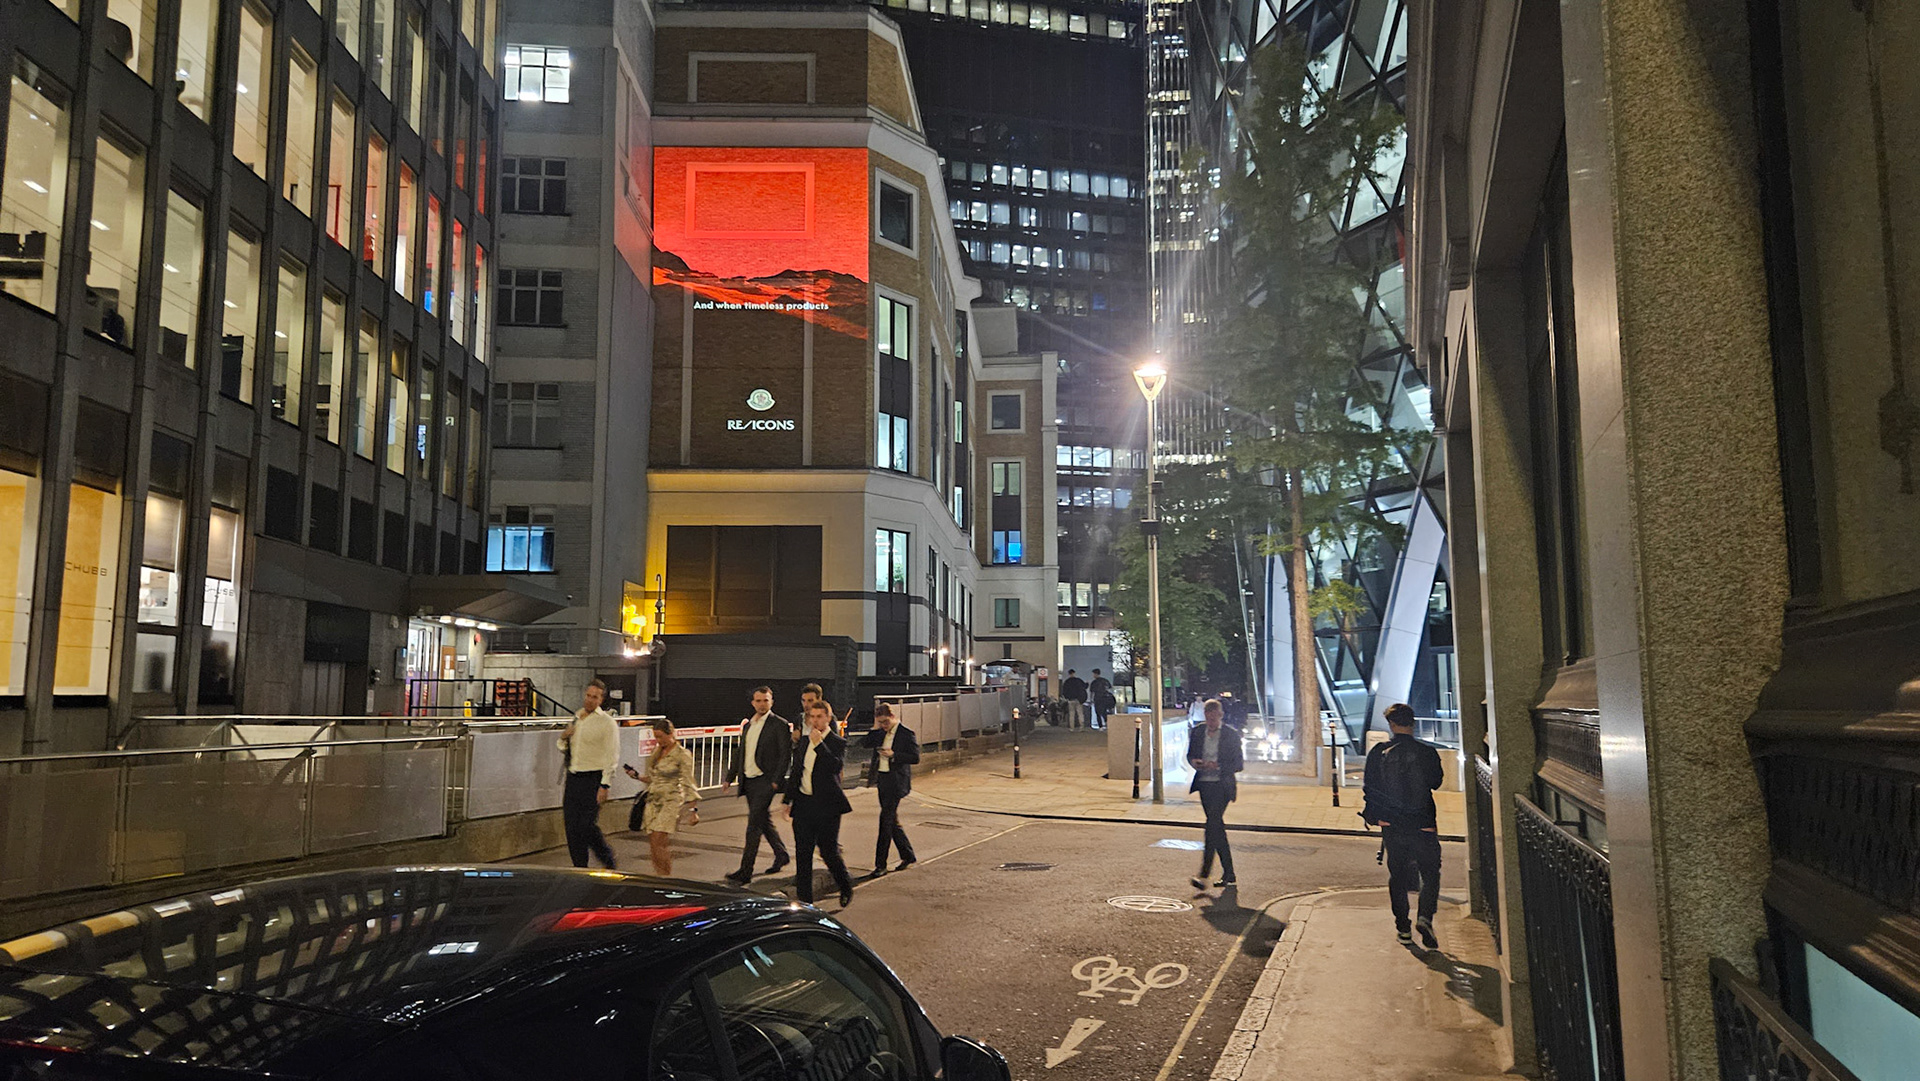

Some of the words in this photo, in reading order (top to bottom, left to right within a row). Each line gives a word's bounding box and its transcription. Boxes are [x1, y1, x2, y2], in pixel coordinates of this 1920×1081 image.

[693, 301, 714, 310] And
[715, 302, 742, 310] when
[743, 301, 784, 310] timeless
[786, 301, 829, 311] products
[65, 561, 108, 577] CHUBB
